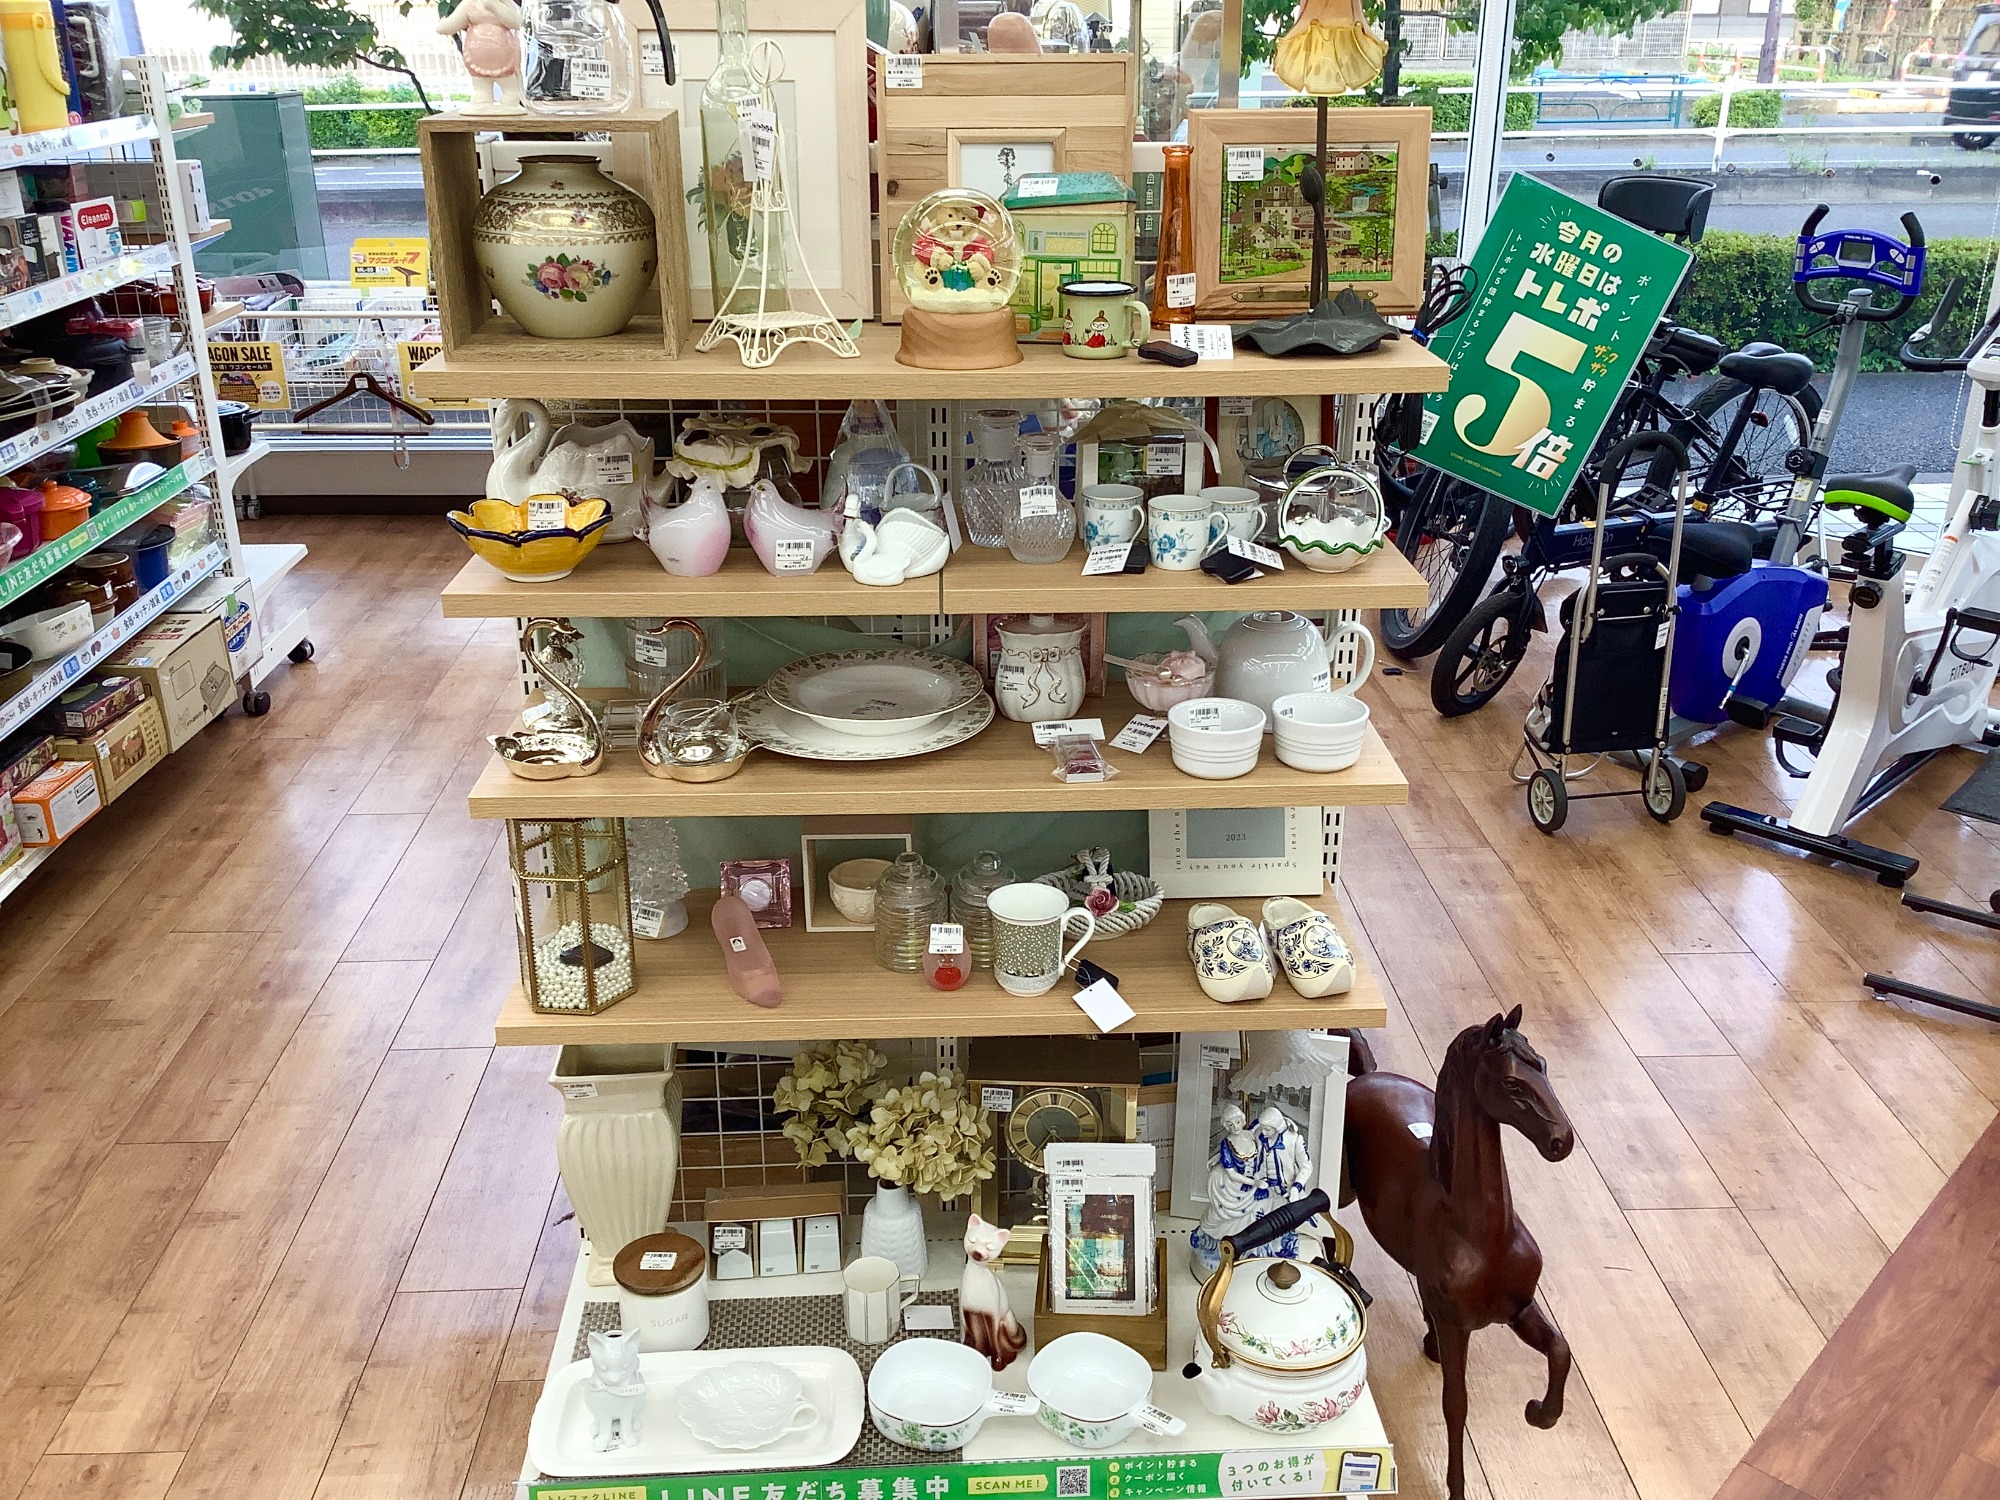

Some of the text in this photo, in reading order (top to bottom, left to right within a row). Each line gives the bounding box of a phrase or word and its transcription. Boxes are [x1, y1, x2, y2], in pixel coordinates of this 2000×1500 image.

[81, 209, 110, 225] Cleansui
[1558, 221, 1622, 263] 今月の
[1530, 241, 1622, 296] 水曜日は
[1513, 268, 1609, 331] トレポ
[1435, 234, 1523, 402] トレポが5倍貯まるアプリはコラ
[208, 346, 271, 361] AGON SALE
[407, 347, 443, 360] WAGO
[85, 388, 130, 421] 食器・キッチン雑貨
[123, 594, 161, 631] 食器・キッチン雑貨
[17, 669, 64, 714] 食器・キッチン雑貨
[1189, 861, 1297, 870] Sparkle your way
[650, 1313, 689, 1328] SUGAR
[1124, 1459, 1197, 1470] ポイント貯まる
[1228, 1453, 1314, 1476] 3つのお得が
[975, 1479, 1011, 1490] SCAN
[1124, 1472, 1185, 1483] クーポン届く
[1231, 1470, 1313, 1492] 付いてくる!
[1124, 1484, 1207, 1496] キャンペーン情報
